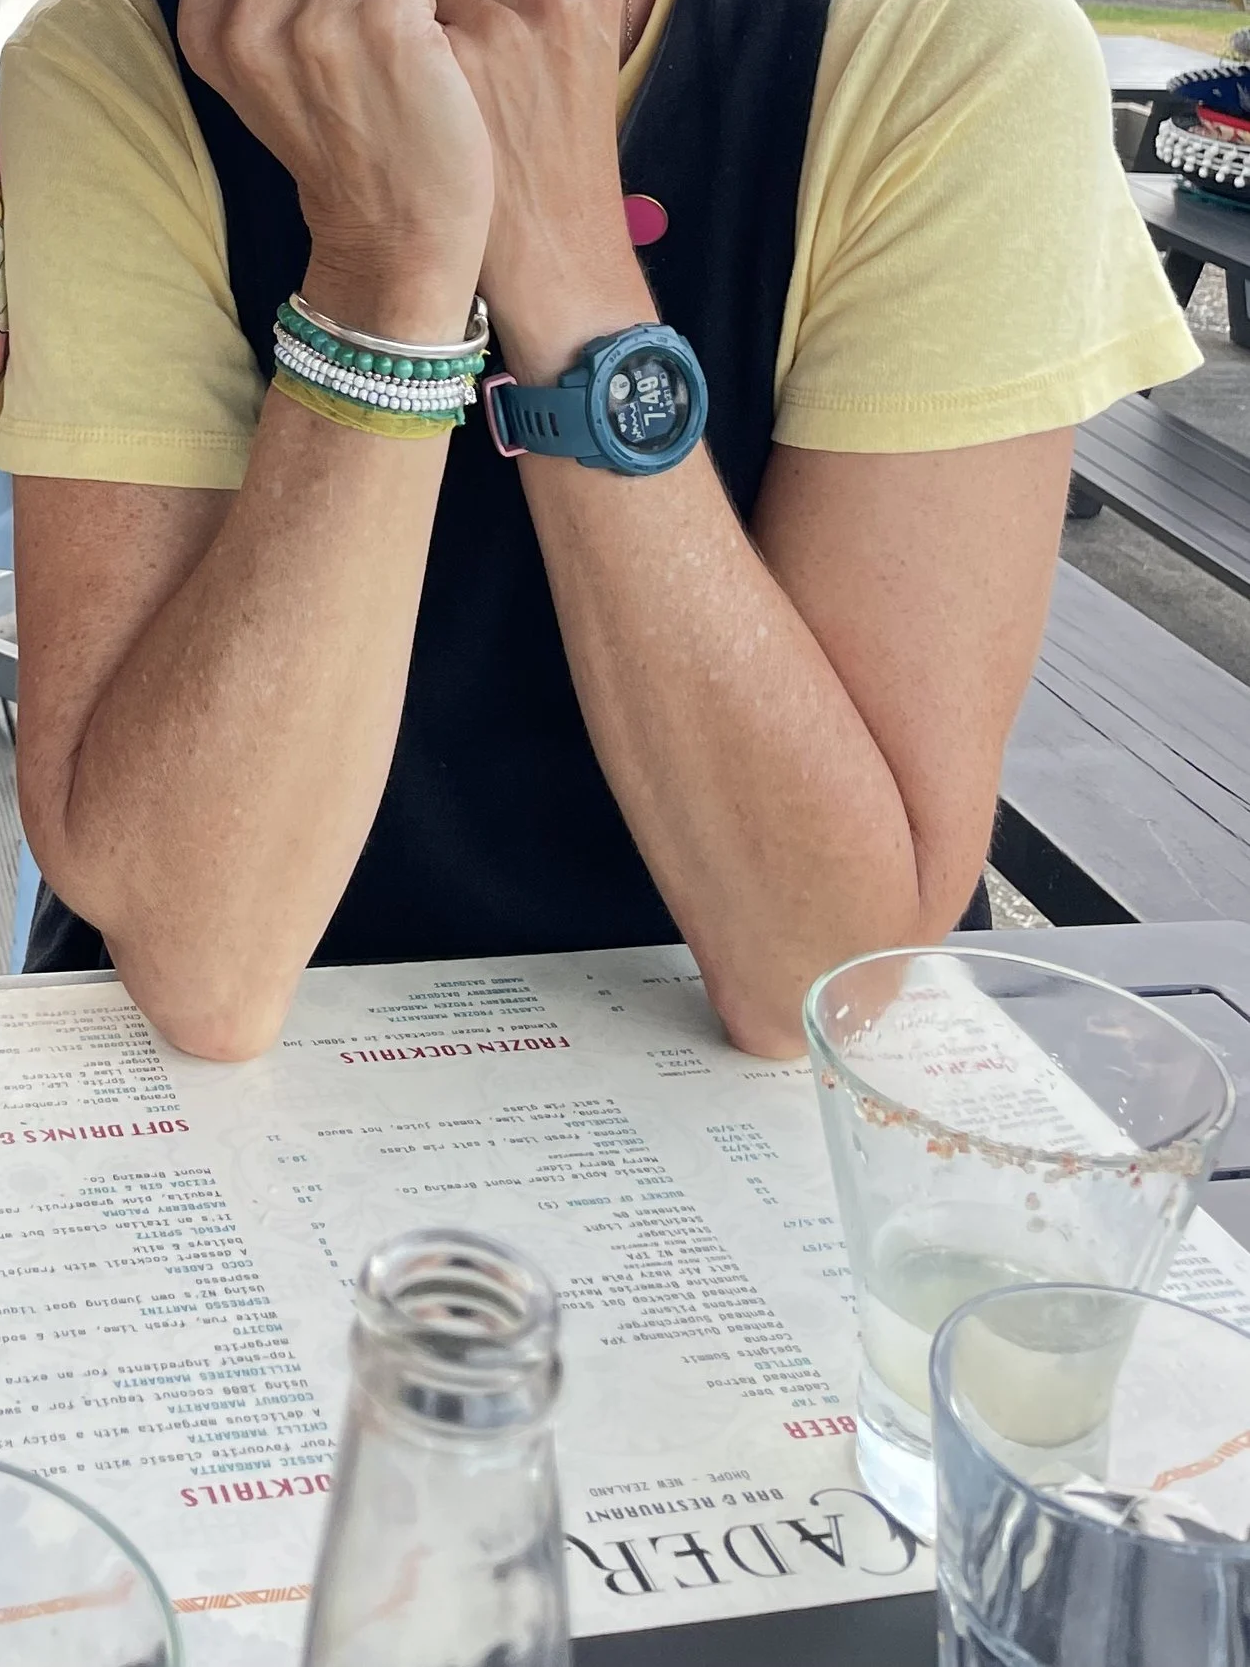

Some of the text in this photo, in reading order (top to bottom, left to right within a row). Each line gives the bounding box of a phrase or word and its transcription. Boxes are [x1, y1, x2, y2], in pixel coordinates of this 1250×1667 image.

[637, 375, 667, 427] 7:49
[386, 1004, 546, 1024] CLASSIC FROZEN MARGARITA
[338, 1034, 571, 1065] FROZEN COCKTAILS
[144, 1103, 181, 1114] JUICE
[130, 1118, 190, 1137] SOFT
[316, 1111, 566, 1138] fresh tomato hot sauce
[562, 1116, 630, 1129] MICHELADA
[21, 1123, 125, 1144] DRINKS
[591, 1136, 645, 1149] CHELADA
[534, 1155, 660, 1173] Merry Berry Cider
[111, 1166, 212, 1182] Mount Brewing
[422, 1164, 667, 1193] Classic Apple Cider Mount Brewing
[633, 1174, 674, 1186] CIDER
[120, 1194, 153, 1206] pink
[100, 1199, 227, 1218] RASPBERRY PALOMA
[633, 1204, 697, 1217] Heineken
[113, 1217, 171, 1230] Italian
[199, 1212, 233, 1223] It's
[582, 1214, 705, 1233] Steinlager Light
[20, 1228, 46, 1239] but
[50, 1222, 108, 1236] classic
[134, 1223, 237, 1241] APEROL SPRITZ
[635, 1224, 713, 1239] Steinlager
[131, 1236, 244, 1254] baileys milk
[677, 1243, 727, 1255] Tumeke
[62, 1248, 233, 1273] dessert cocktail with
[624, 1249, 651, 1261] IPA
[163, 1258, 254, 1275] COCO CADERA
[638, 1268, 673, 1279] Hazy
[676, 1265, 702, 1276] Air
[706, 1261, 741, 1274] Salt
[193, 1272, 260, 1286] espresso
[569, 1275, 595, 1286] Ale
[600, 1271, 635, 1283] Pale
[607, 1273, 750, 1295] Sunshine Breweries
[149, 1292, 176, 1302] own
[182, 1288, 218, 1300] NZ's
[222, 1283, 266, 1296] Using
[599, 1284, 758, 1308] Panhead Blacktop Oat
[44, 1299, 78, 1313] goat
[83, 1293, 143, 1308] jumping
[138, 1295, 272, 1317] ESPRESSO MARTINI
[639, 1295, 767, 1316] Emersons Pilsner
[234, 1309, 279, 1322] White
[615, 1308, 776, 1331] Panhead Supercharger
[143, 1317, 187, 1332] fresh
[231, 1322, 284, 1337] MOJITO
[52, 1327, 87, 1340] mint
[598, 1319, 785, 1347] Panhead Quickchange XPA
[741, 1331, 794, 1344] Corona
[212, 1336, 290, 1353] margarita
[219, 1349, 297, 1367] Top-shelf
[679, 1342, 803, 1365] Speights Summit
[116, 1357, 211, 1375] ingredients
[752, 1355, 813, 1371] BOTTLED
[3, 1372, 49, 1386] extra
[81, 1366, 109, 1378] for
[111, 1362, 302, 1389] MILLIONAIRES MARGARITA
[704, 1368, 822, 1390] Panhead Ratrod
[262, 1377, 309, 1391] Using
[739, 1380, 831, 1399] Cadera beer
[82, 1392, 145, 1408] tequila
[152, 1386, 214, 1402] coconut
[47, 1398, 75, 1411] for
[165, 1390, 315, 1415] COCONUT MARGARITA
[790, 1396, 817, 1409] TAP
[224, 1408, 304, 1425] delicious
[92, 1425, 131, 1439] with
[136, 1417, 218, 1434] margarita
[185, 1420, 329, 1444] CHILLI MARGARITA
[781, 1414, 858, 1440] BEER
[21, 1431, 67, 1446] spicy
[93, 1437, 337, 1472] Your favourite classic with
[188, 1457, 272, 1477] MARGARITA
[178, 1473, 331, 1508] OCKTAILS
[587, 1476, 685, 1498] NEW ZEALAND
[583, 1487, 785, 1524] BAR RESTAURANT
[566, 1487, 932, 1597] CADER
